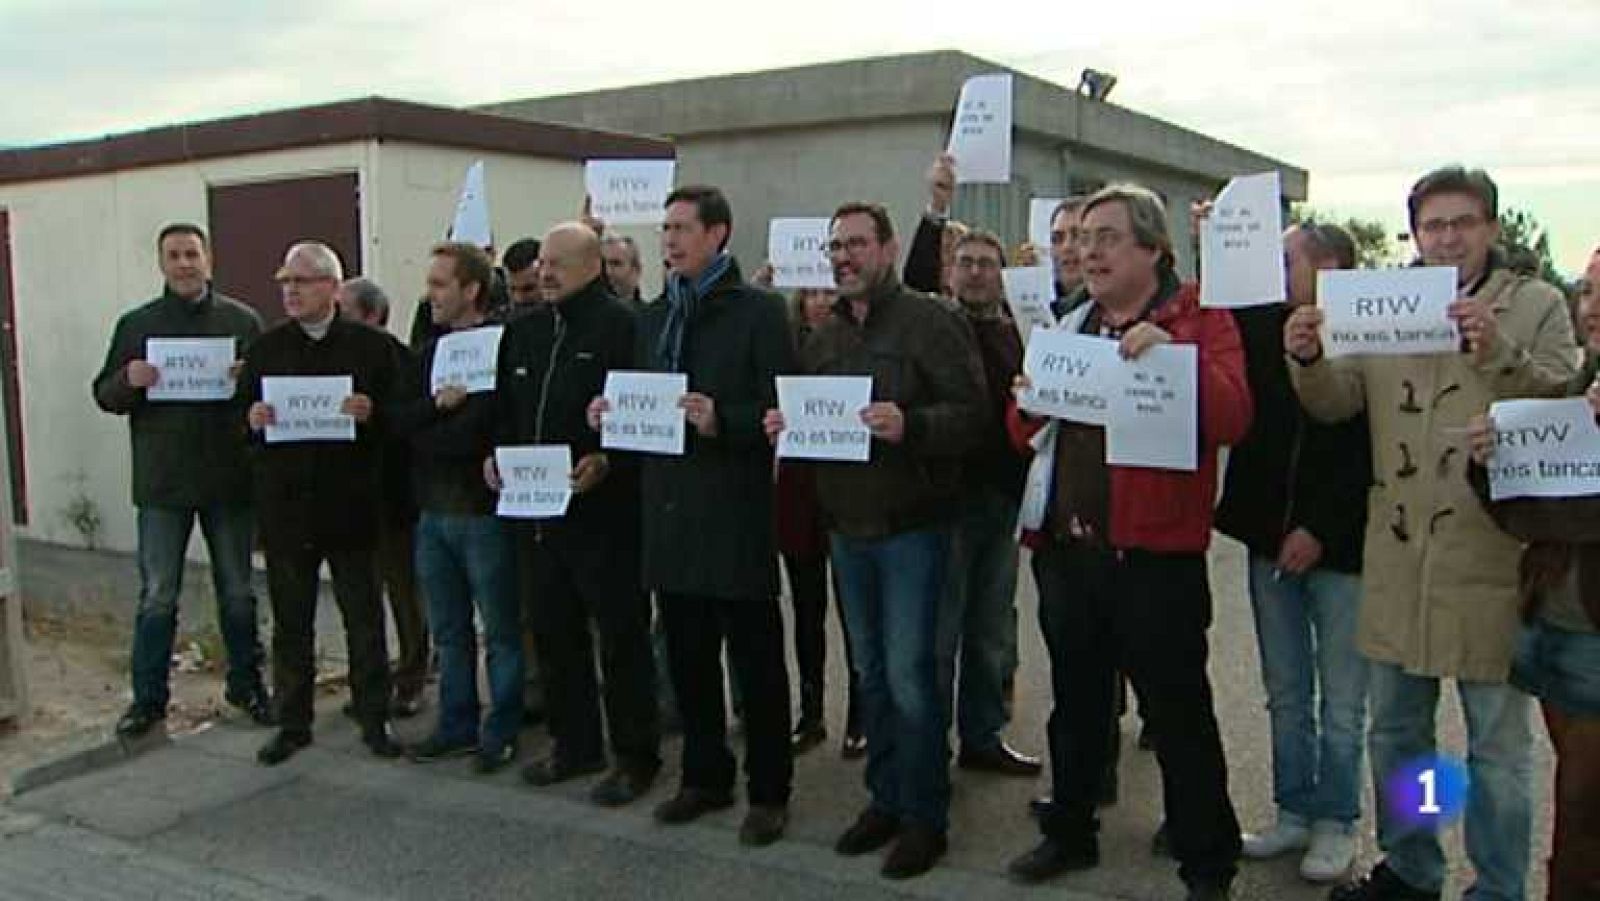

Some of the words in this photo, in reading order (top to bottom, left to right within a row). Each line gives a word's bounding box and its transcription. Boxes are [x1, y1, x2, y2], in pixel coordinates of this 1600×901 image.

[1355, 295, 1421, 317] RTVV
[1332, 331, 1359, 342] no
[1364, 330, 1391, 342] es
[1394, 328, 1455, 342] tanca
[1041, 353, 1091, 378] RTVV
[286, 396, 332, 411] RTVV
[618, 393, 657, 409] RTVV
[803, 400, 846, 416] RTVV
[809, 431, 827, 443] es
[1497, 422, 1571, 447] RTVV
[1503, 464, 1531, 479] es
